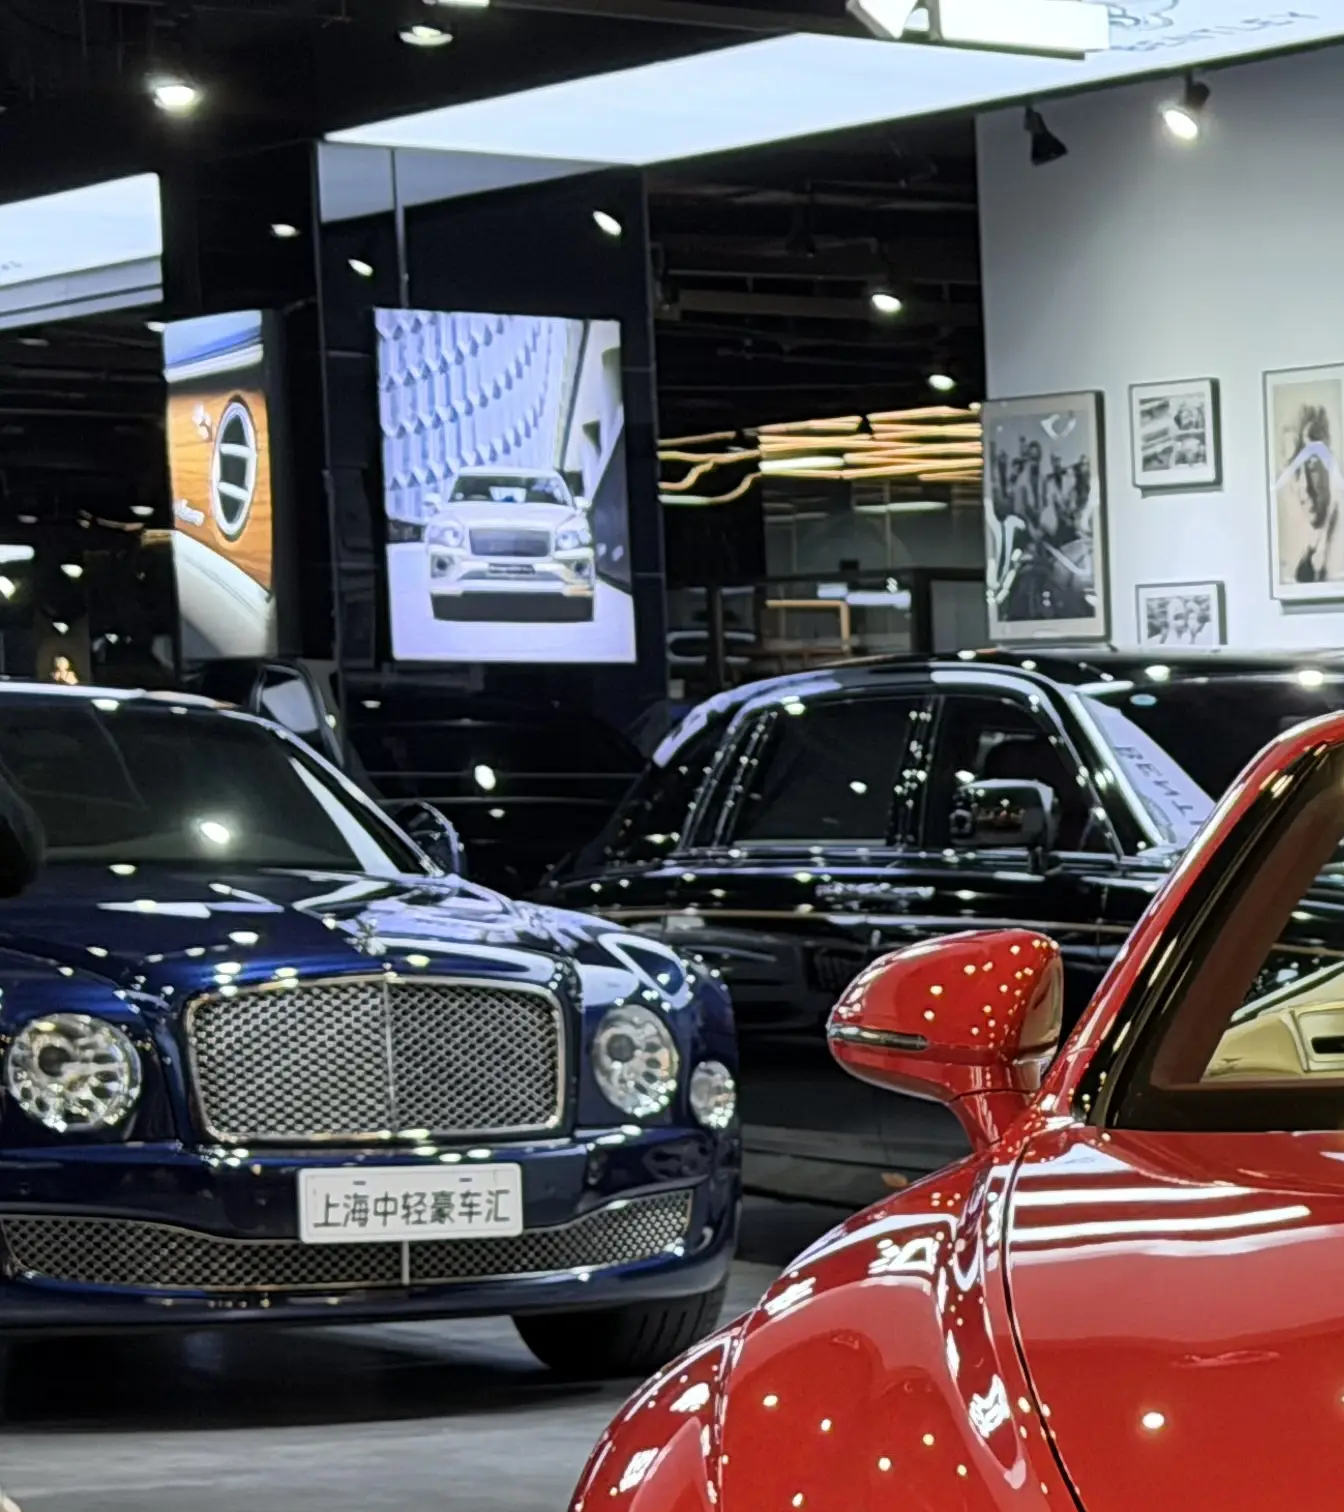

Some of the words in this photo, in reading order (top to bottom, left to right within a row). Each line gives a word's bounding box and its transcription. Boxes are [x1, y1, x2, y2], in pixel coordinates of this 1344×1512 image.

[313, 1188, 511, 1228] 上海中轻豪车汇
